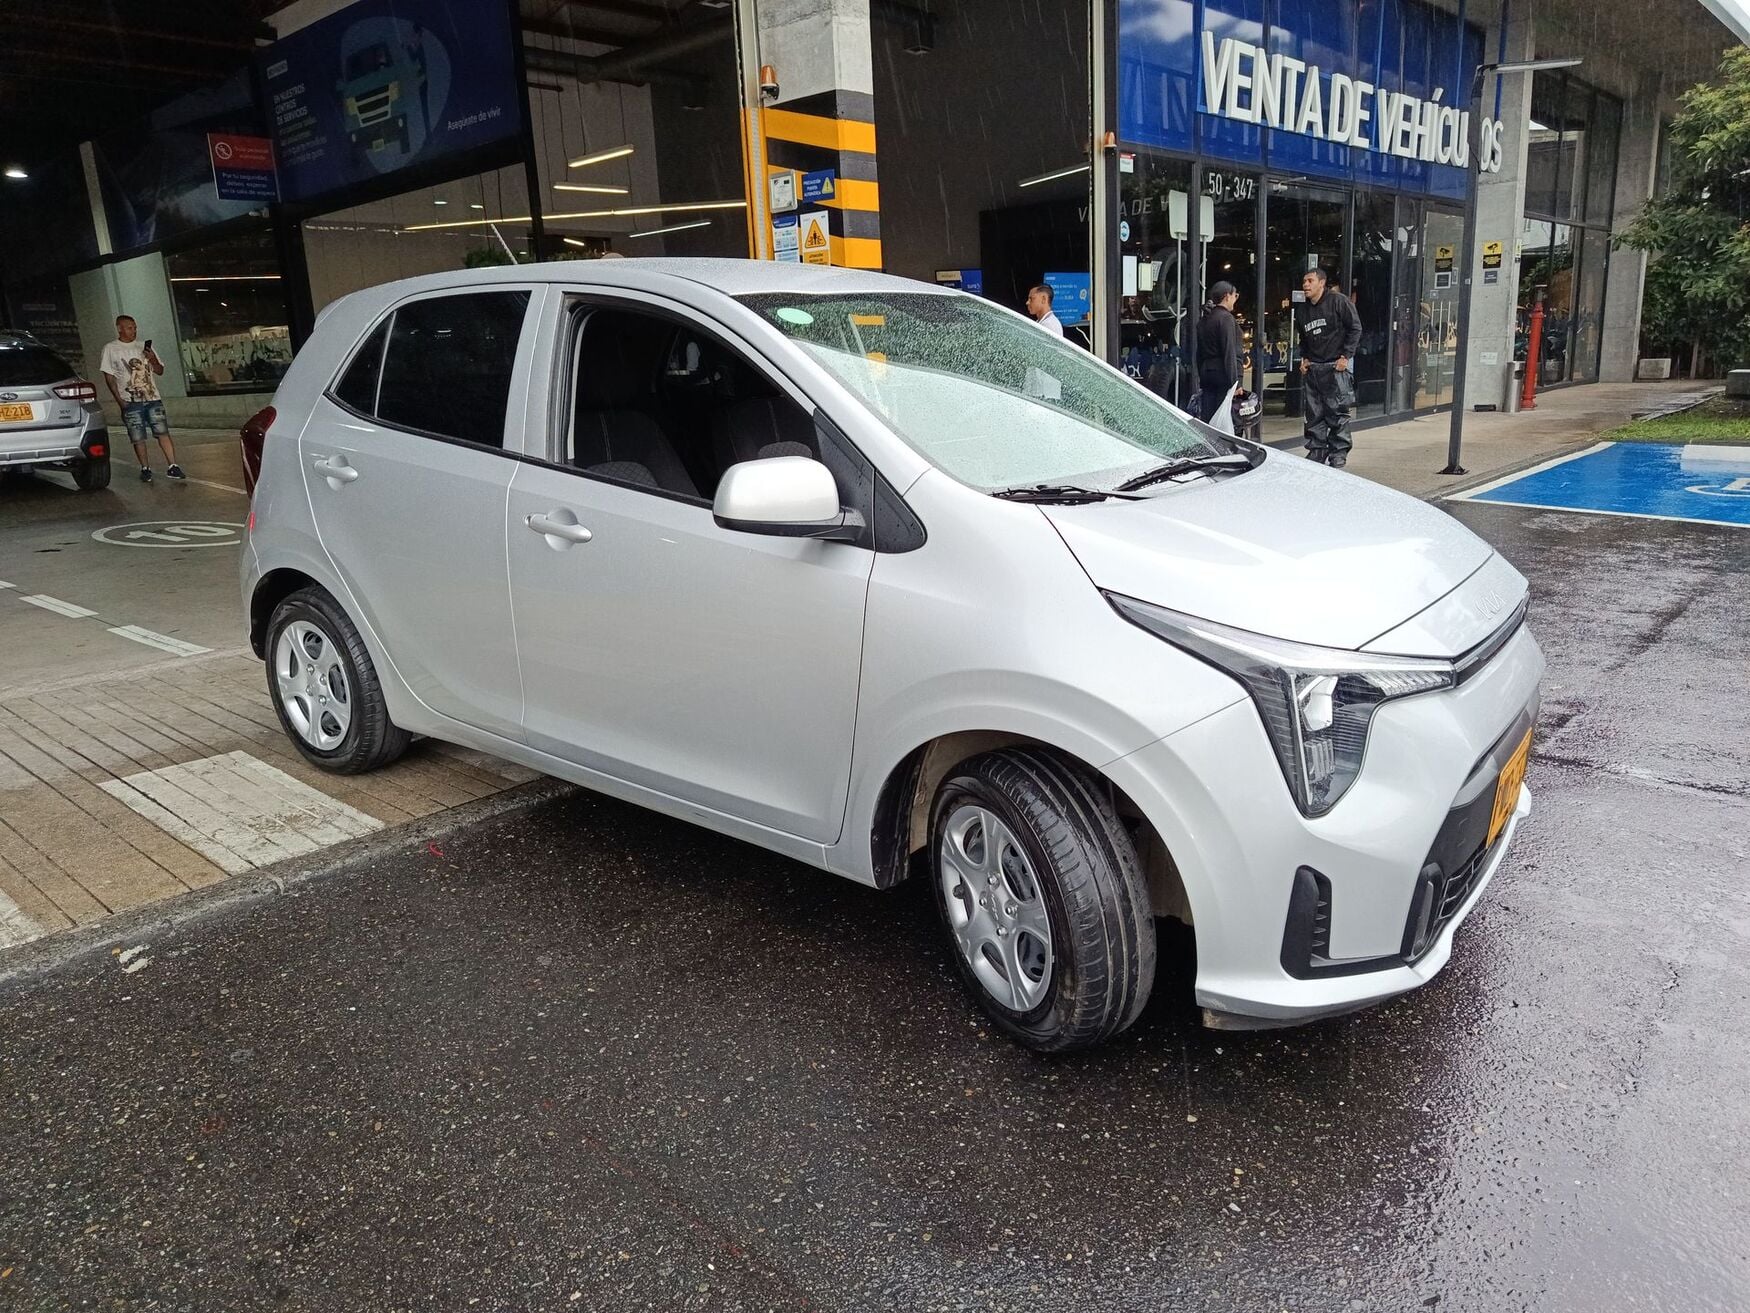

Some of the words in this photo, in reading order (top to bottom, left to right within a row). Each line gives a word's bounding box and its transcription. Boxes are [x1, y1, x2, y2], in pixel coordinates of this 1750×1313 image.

[1202, 30, 1324, 138] VENTA
[1328, 73, 1374, 149] DE
[1377, 88, 1503, 174] VEHÍCUOS
[1208, 172, 1223, 195] 50
[1233, 176, 1253, 200] 347
[125, 525, 236, 542] 10
